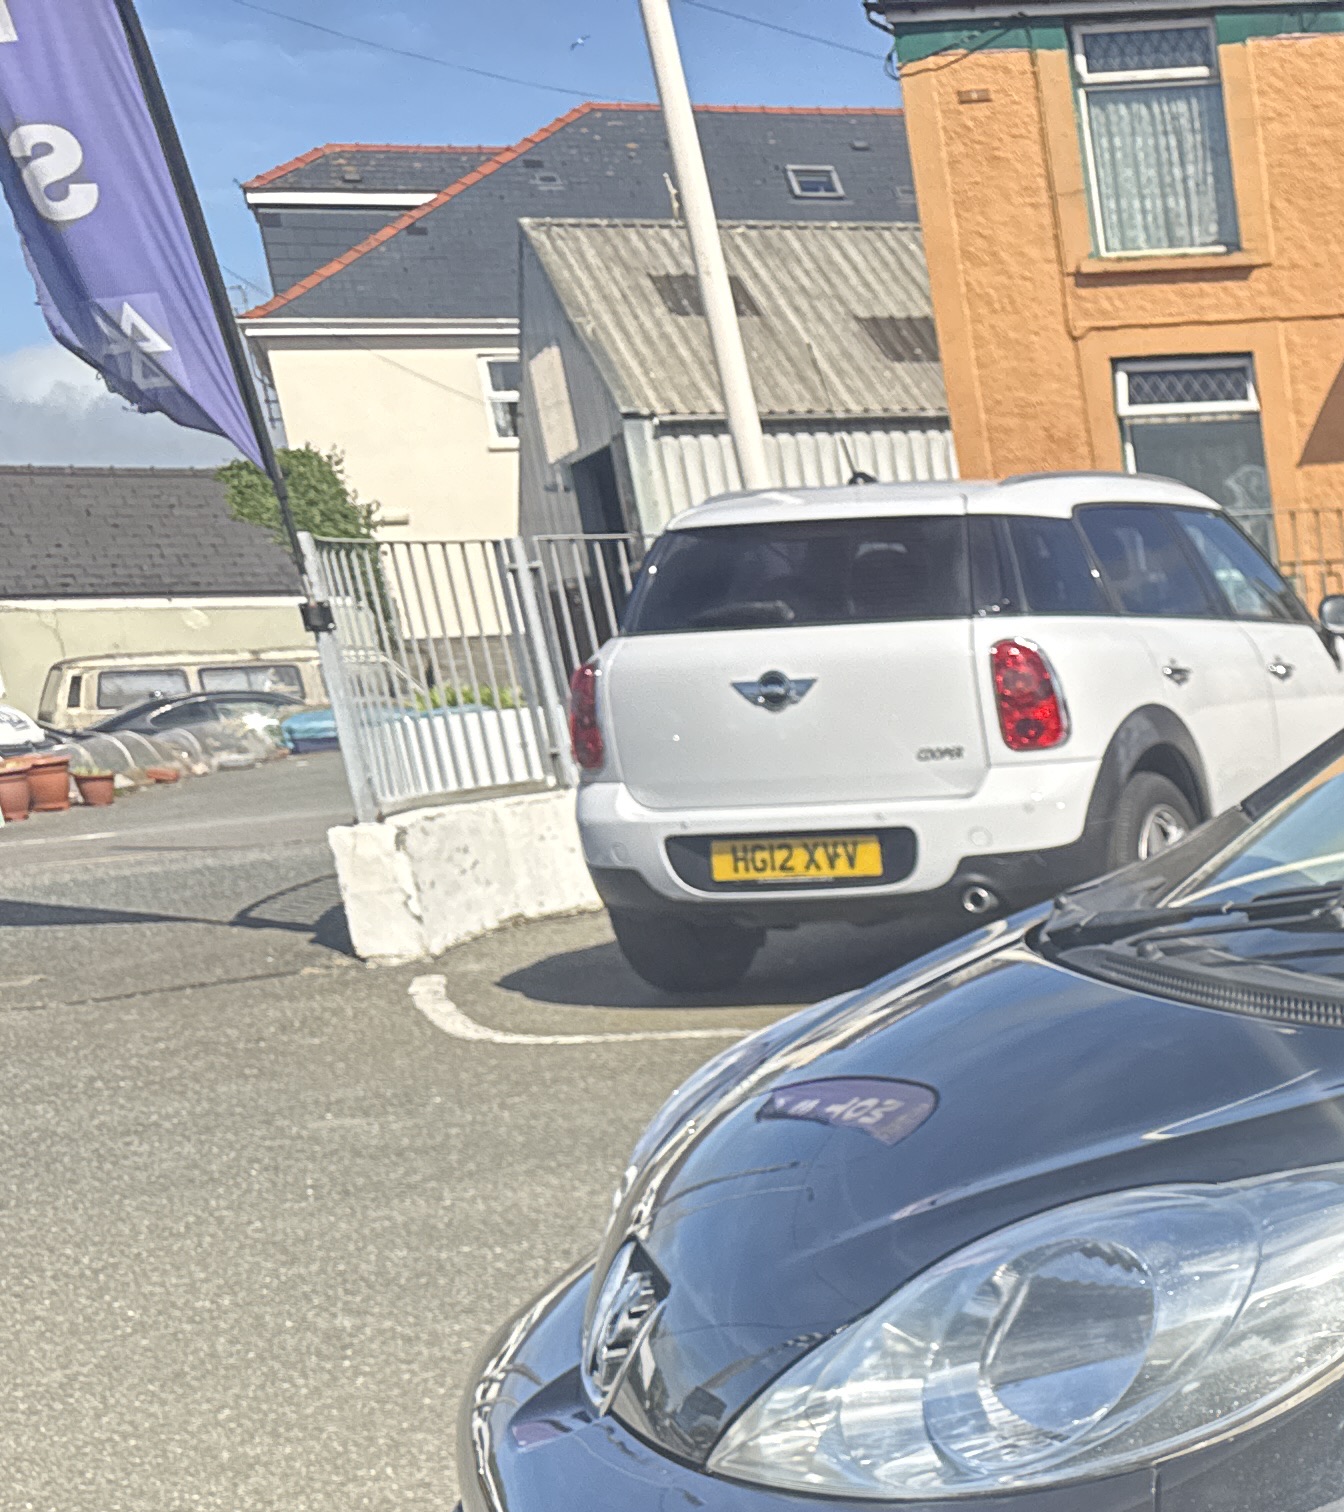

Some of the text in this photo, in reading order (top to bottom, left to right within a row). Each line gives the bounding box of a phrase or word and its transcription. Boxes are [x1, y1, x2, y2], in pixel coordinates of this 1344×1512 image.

[916, 746, 965, 762] COOPER
[731, 839, 859, 874] HG12 XVV
